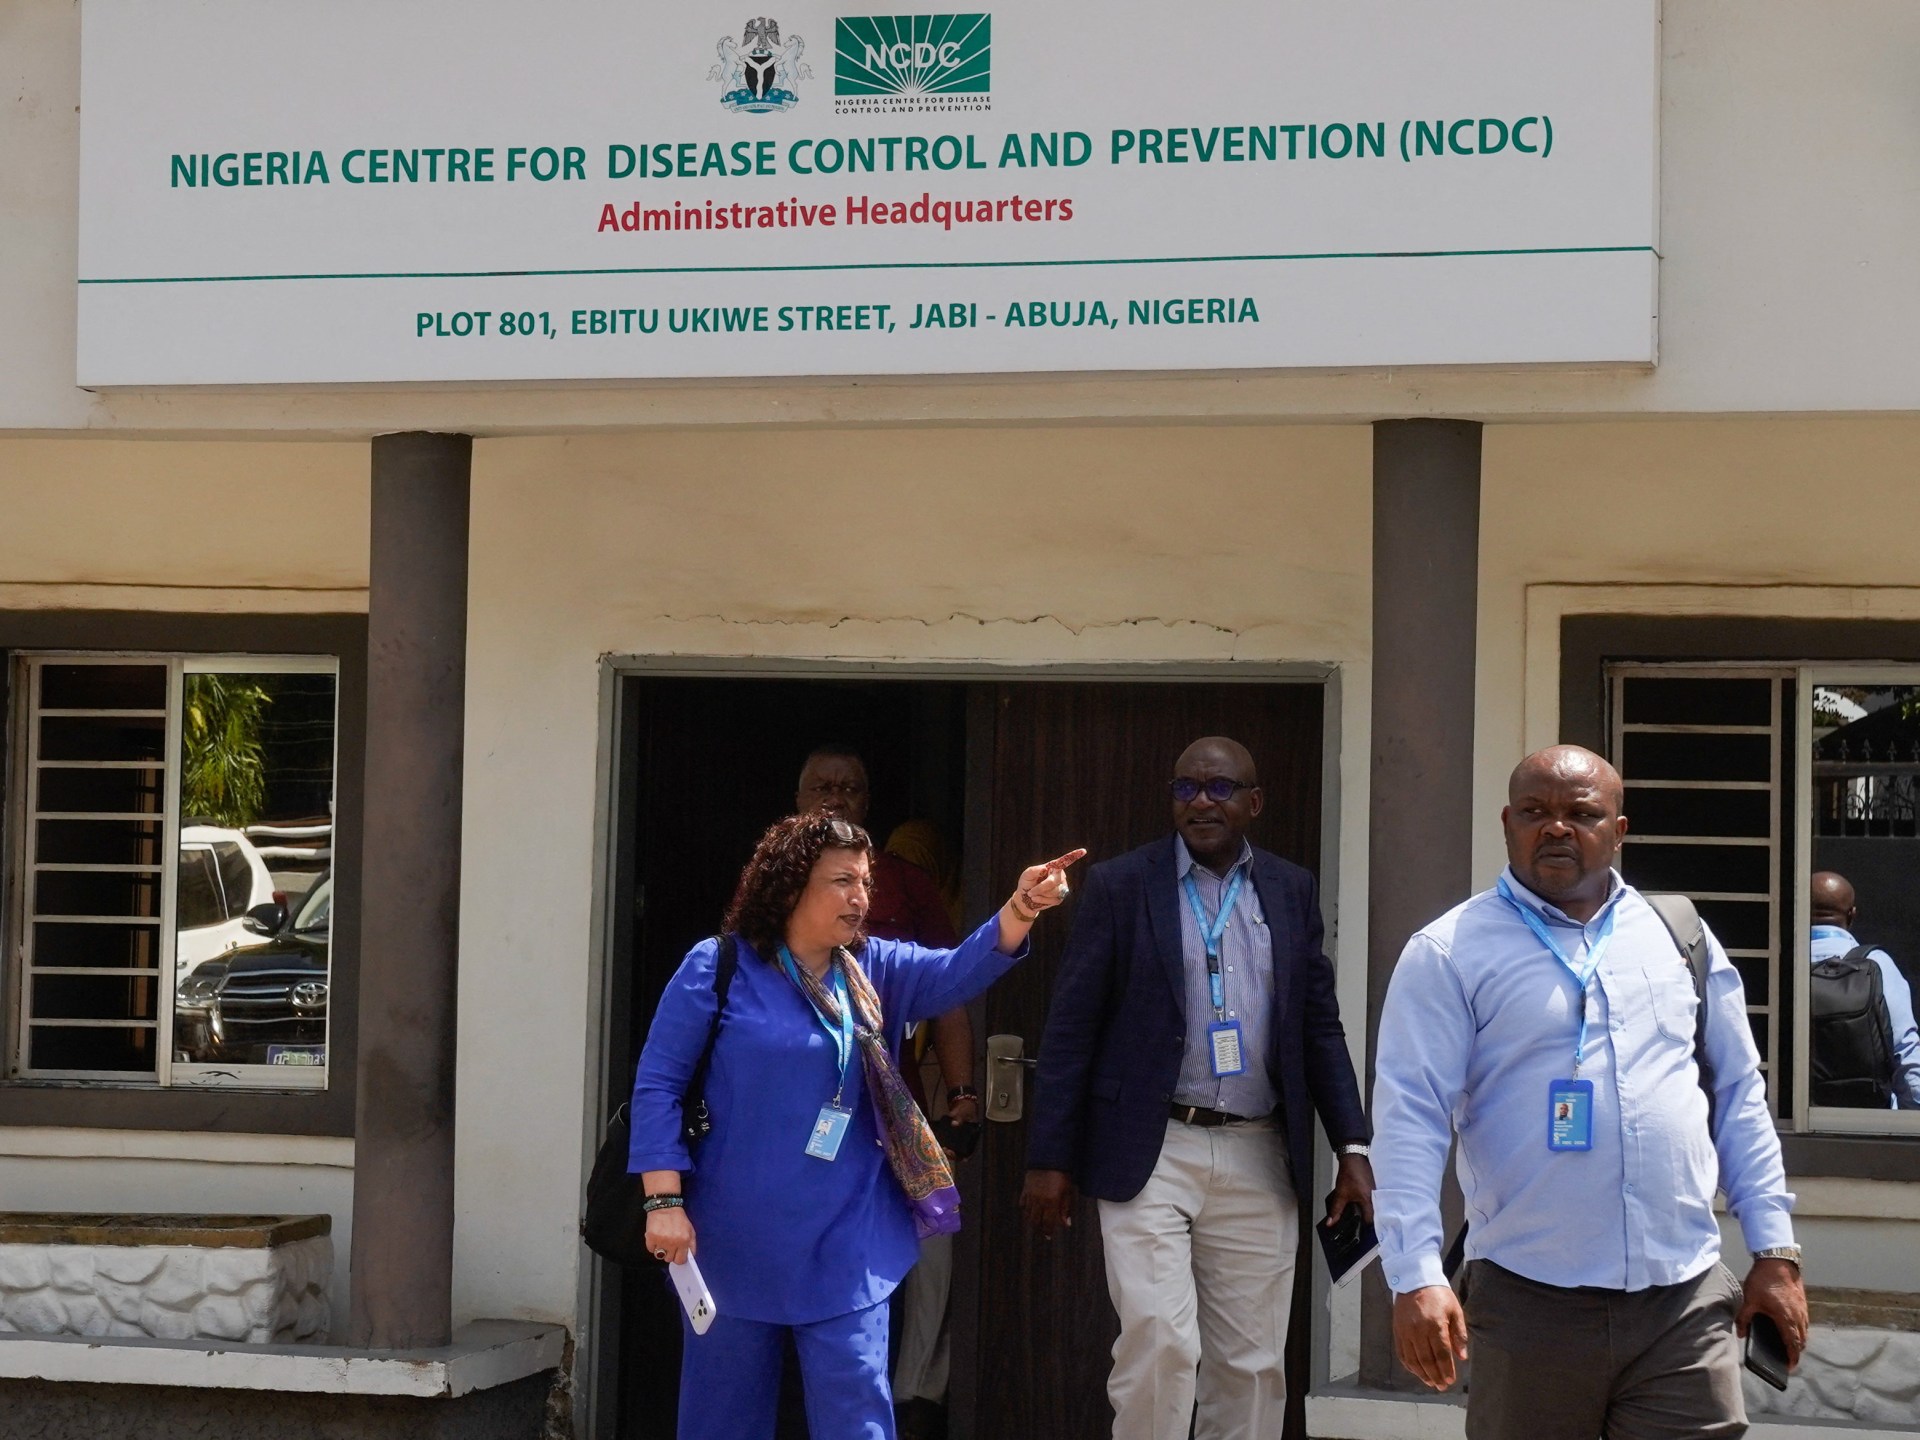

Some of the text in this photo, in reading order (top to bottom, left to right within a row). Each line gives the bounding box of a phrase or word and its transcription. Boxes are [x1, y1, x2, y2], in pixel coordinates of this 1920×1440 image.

[865, 41, 961, 69] NCDC
[835, 98, 879, 106] NIGERIA
[882, 97, 921, 105] CENTRE
[835, 107, 887, 115] CONTROL
[171, 115, 1553, 188] NIGERIA CENTRE FOR DISEASE CONTROL AND PREVENTION (NCDC)
[597, 192, 1074, 233] Administrative Headquarters
[416, 311, 492, 338] PLOT
[498, 310, 557, 340] 801,
[571, 308, 659, 335] EBITU
[668, 306, 769, 334] UKIWE
[777, 303, 896, 334] STREET,
[909, 302, 977, 329] JABI
[1004, 300, 1119, 330] ABUJA,
[1128, 297, 1260, 326] NIGERIA
